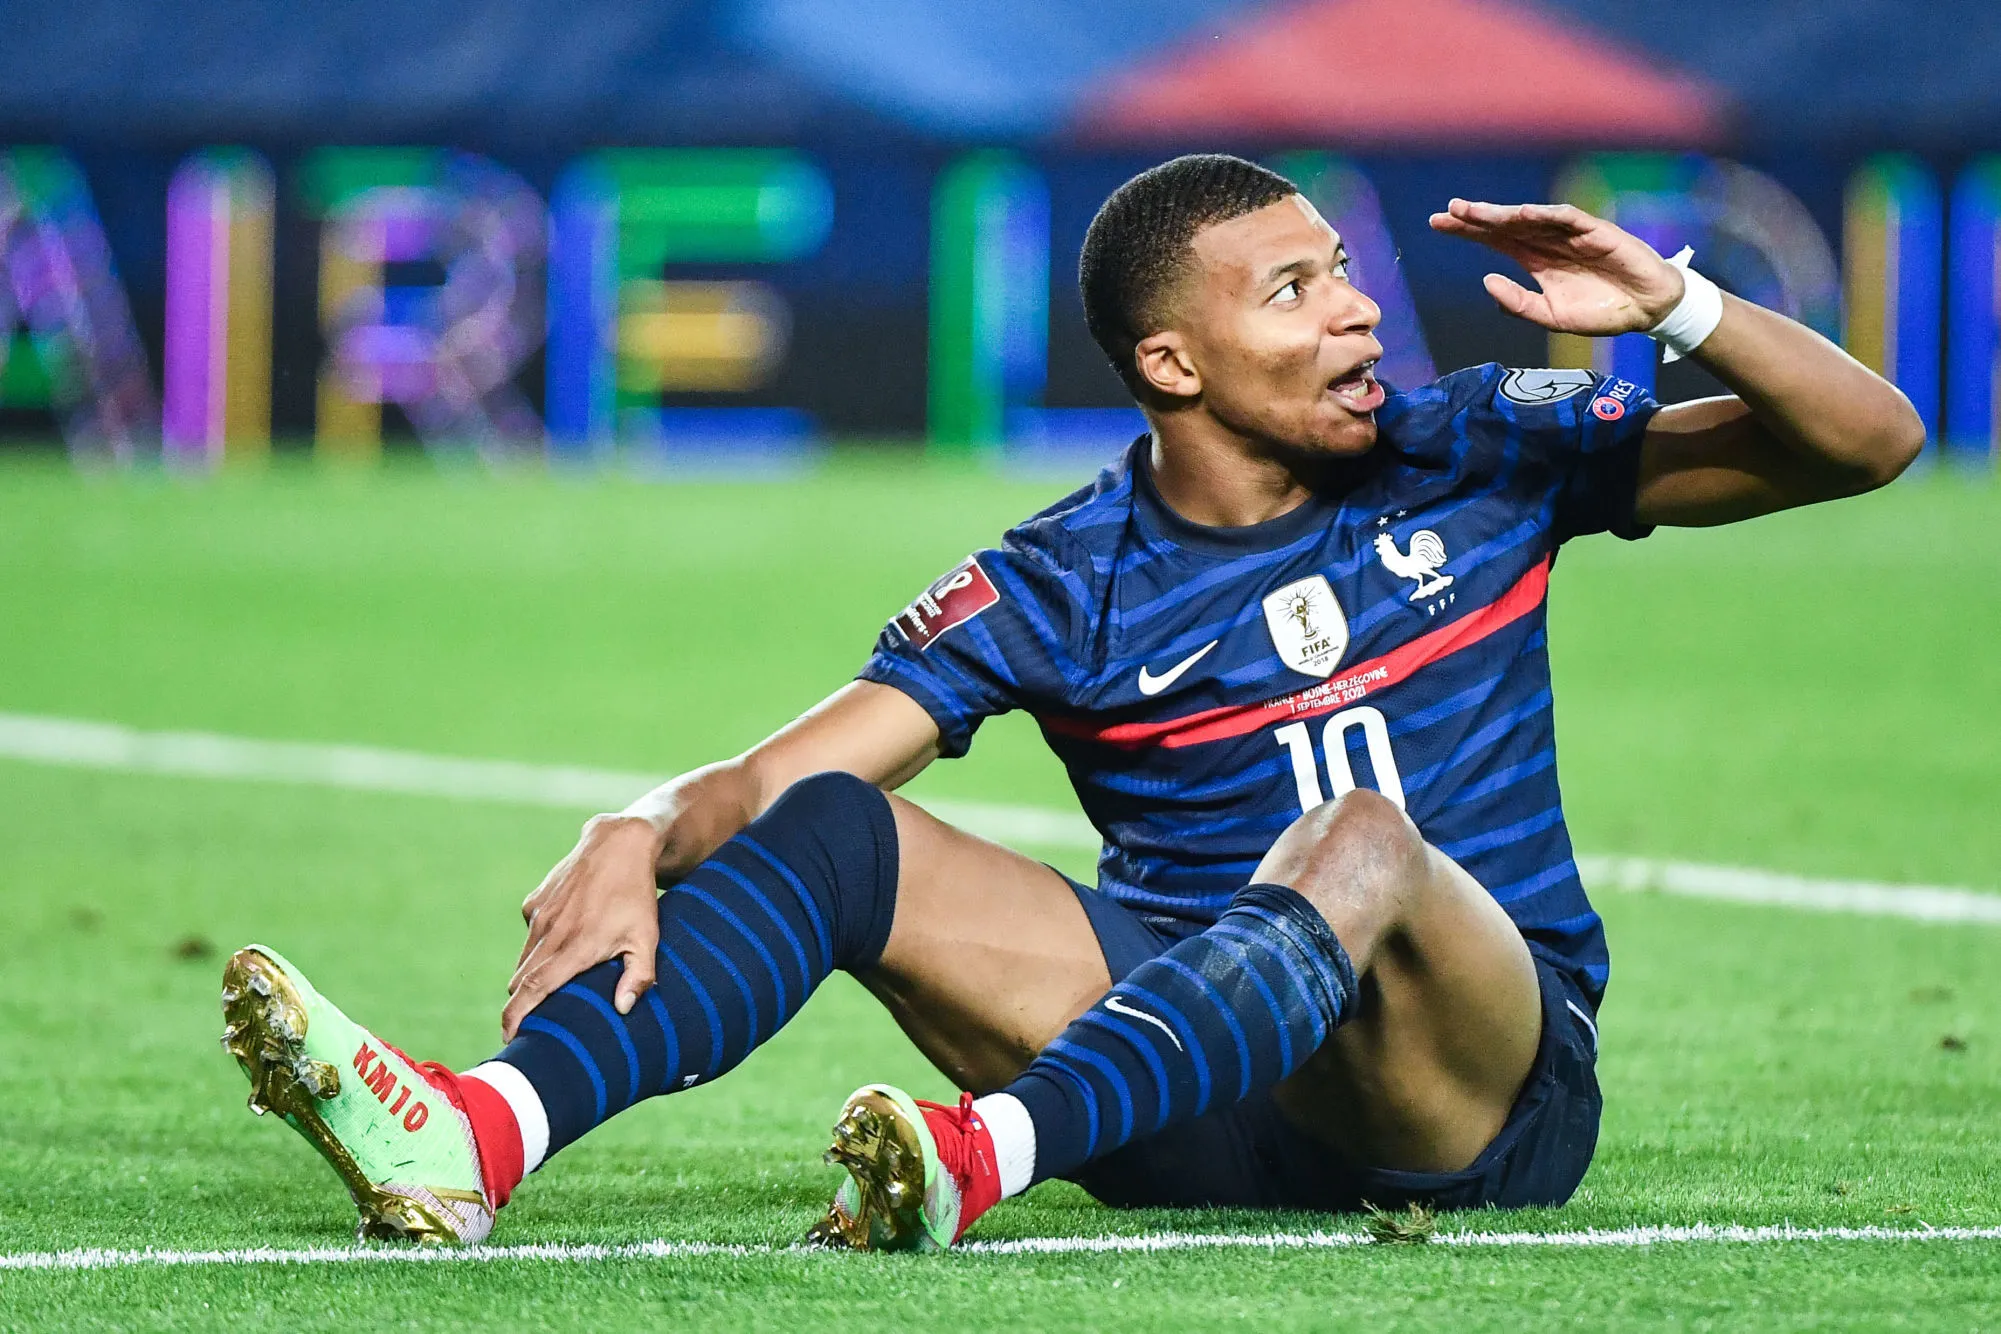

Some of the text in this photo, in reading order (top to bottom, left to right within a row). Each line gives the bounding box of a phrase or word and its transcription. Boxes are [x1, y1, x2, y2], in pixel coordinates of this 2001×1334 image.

[1301, 638, 1330, 658] FIFA
[1289, 684, 1367, 715] 1 SEPTEMBRE 2021
[1273, 705, 1406, 815] 10
[353, 1040, 429, 1133] KM10
